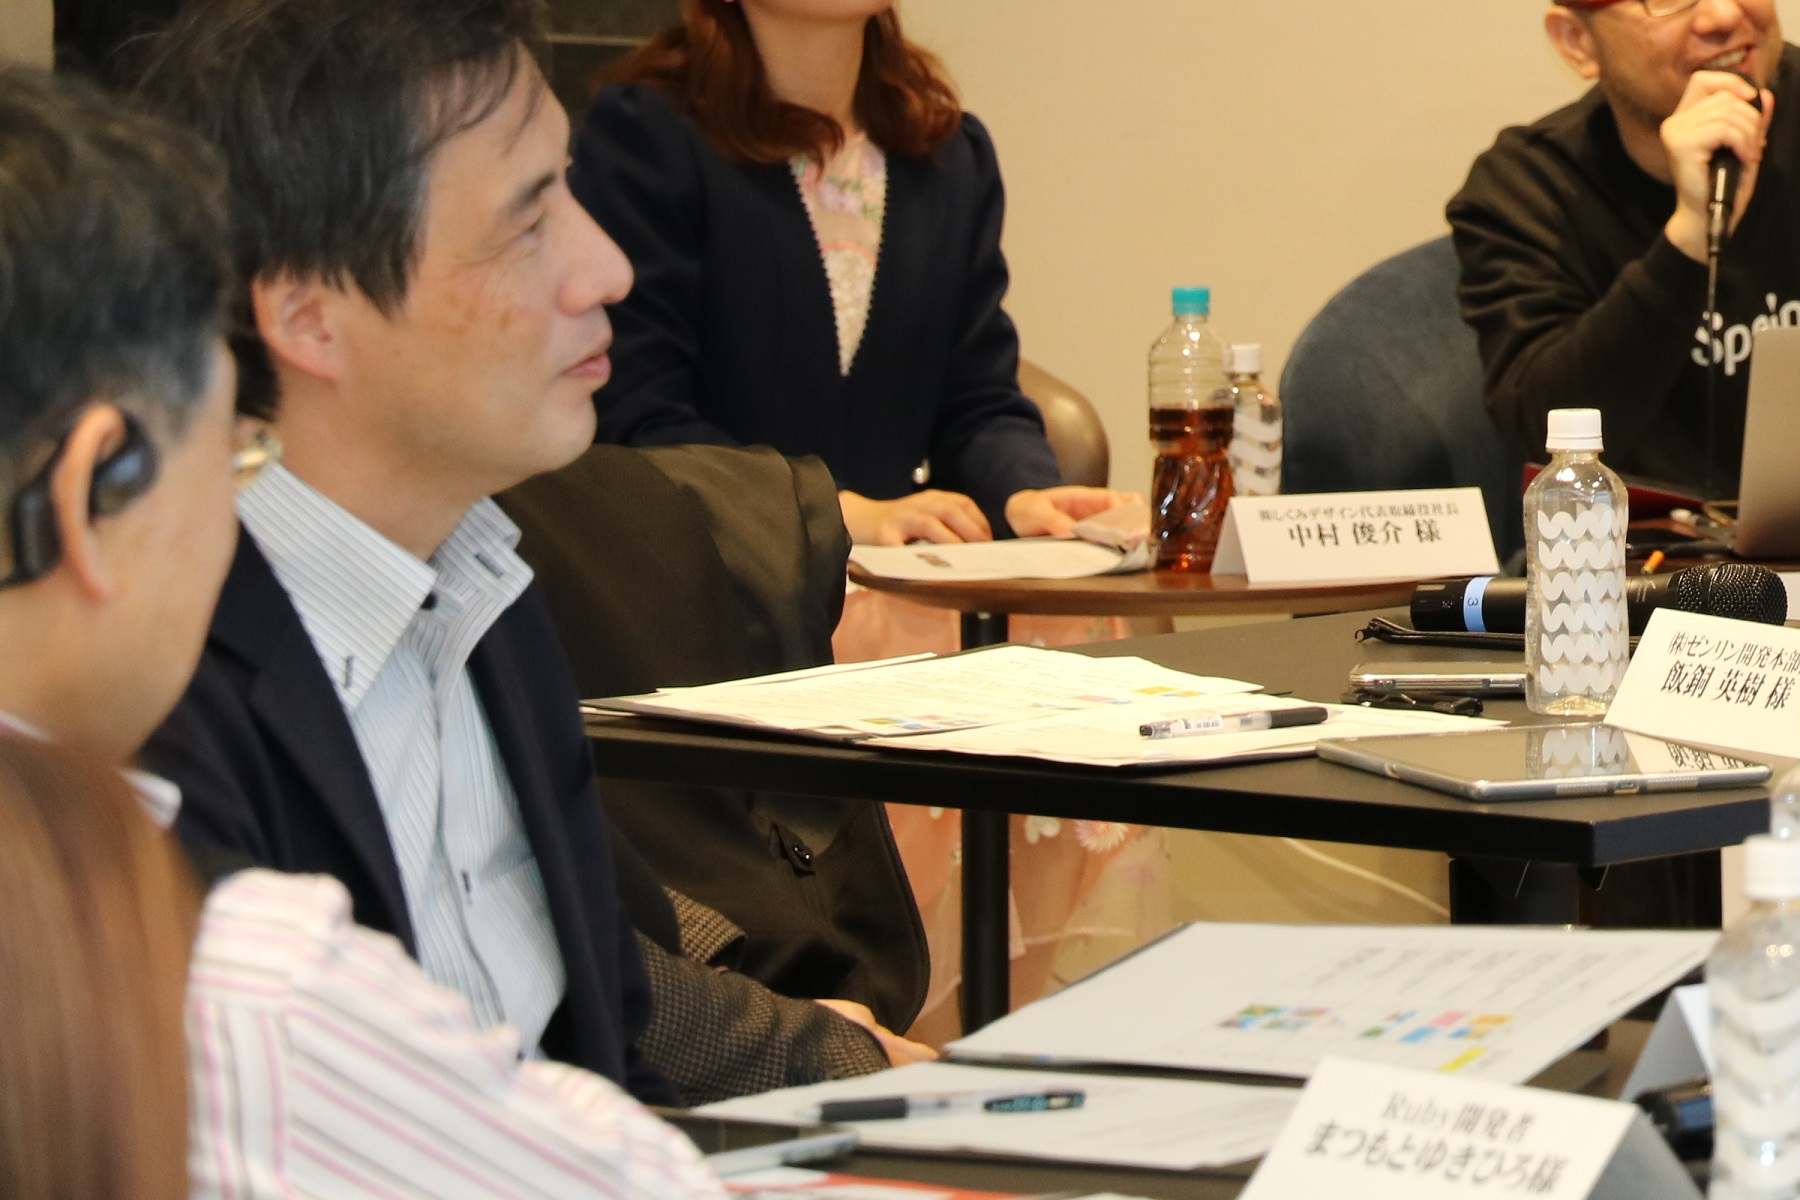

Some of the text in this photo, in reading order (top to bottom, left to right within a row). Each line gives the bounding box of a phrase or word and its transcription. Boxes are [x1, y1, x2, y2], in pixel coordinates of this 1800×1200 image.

[1288, 519, 1442, 547] 中村 俊介 様
[1711, 668, 1767, 706] 英樹
[1764, 676, 1796, 710] 様
[1305, 1117, 1570, 1193] まつもとゆきひろ様
